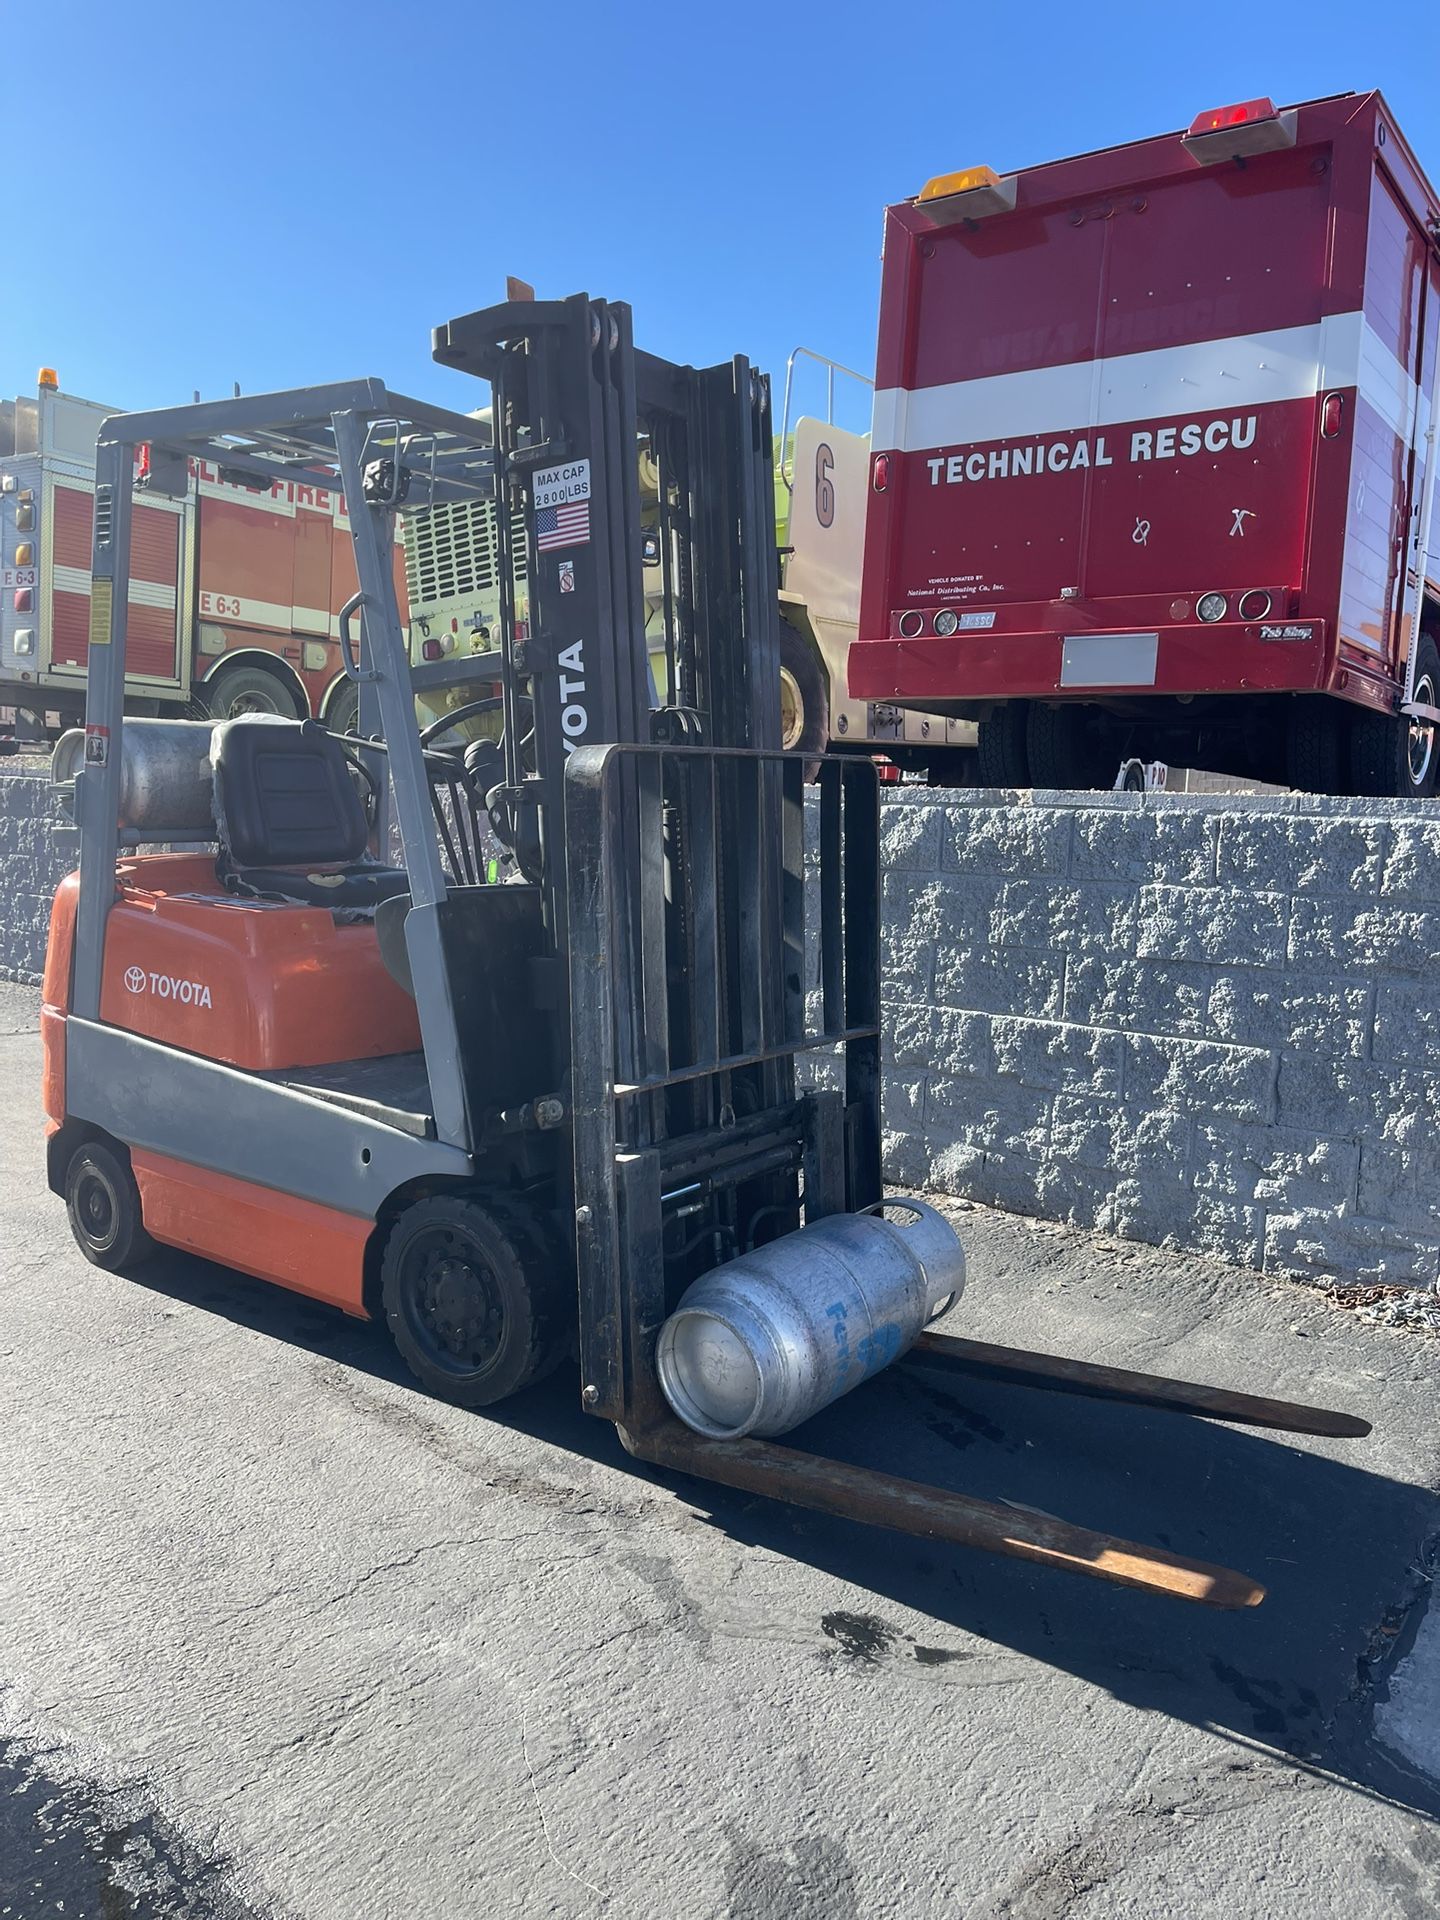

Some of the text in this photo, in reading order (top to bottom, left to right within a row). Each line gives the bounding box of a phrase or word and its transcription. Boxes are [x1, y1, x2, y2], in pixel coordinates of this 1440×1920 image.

[927, 415, 1257, 486] TECHNICAL RESCU
[537, 465, 585, 487] MAX CAP
[815, 442, 835, 529] 6
[271, 479, 330, 510] FIRE
[567, 481, 588, 497] LBS
[4, 570, 35, 585] E 6-3
[907, 588, 935, 597] National
[937, 585, 977, 595] Distributing
[992, 583, 1005, 591] Inc.
[201, 593, 241, 617] E 6-3
[149, 972, 212, 1009] TOYOTA
